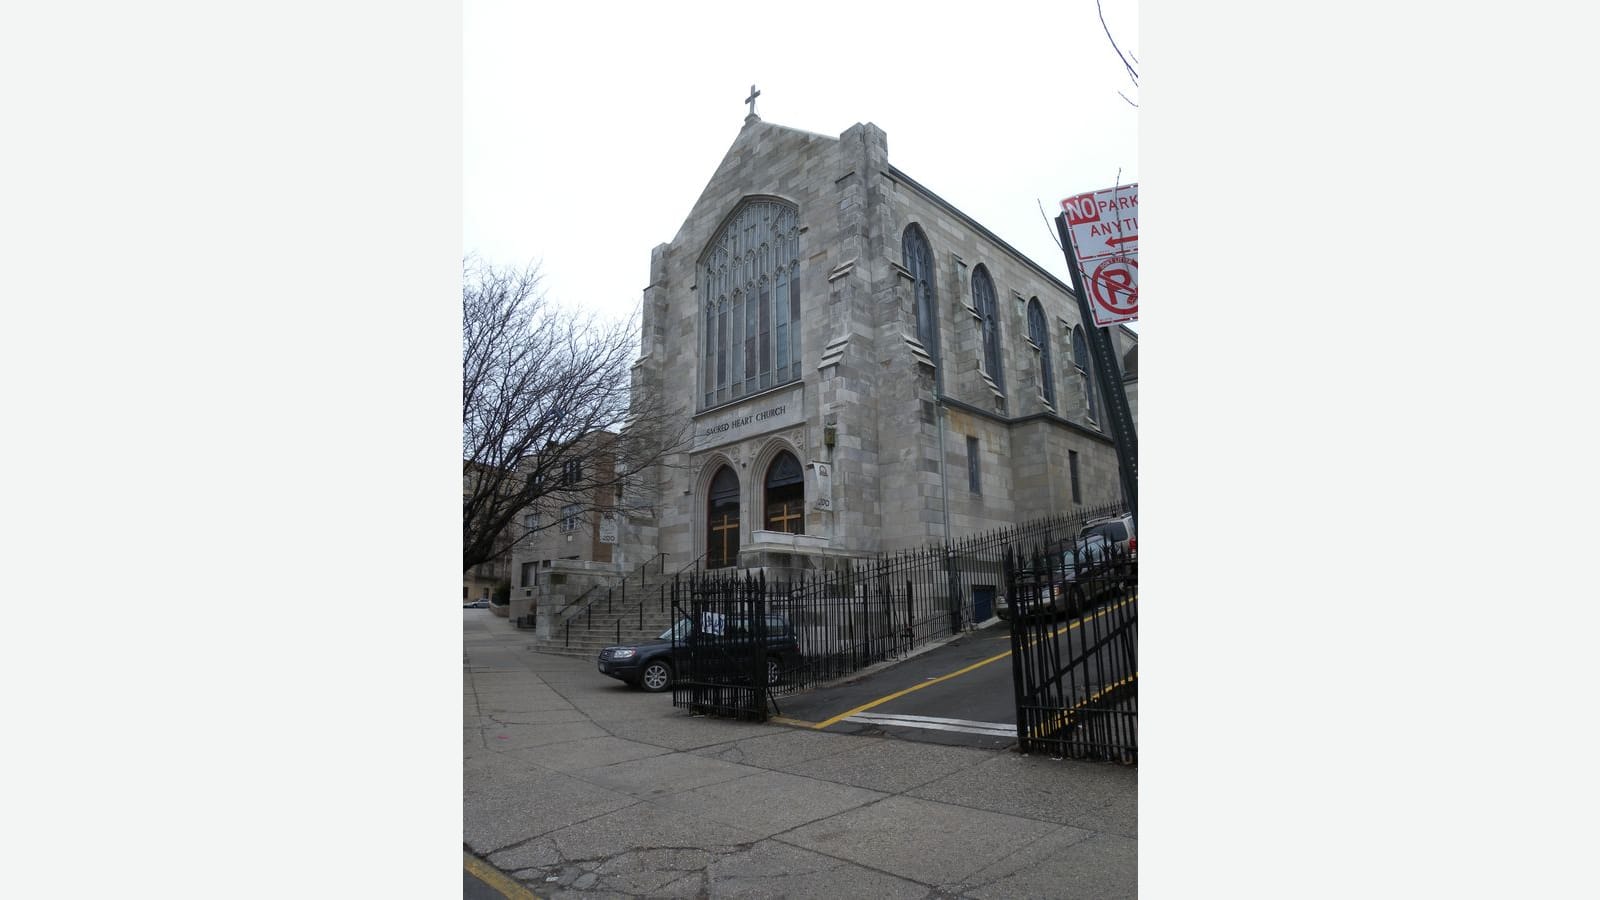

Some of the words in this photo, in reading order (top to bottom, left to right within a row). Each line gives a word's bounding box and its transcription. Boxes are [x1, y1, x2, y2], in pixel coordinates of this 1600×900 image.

[1065, 197, 1097, 221] NO
[706, 423, 730, 436] SACRED
[731, 415, 753, 430] HEART
[755, 405, 786, 422] CHURCH
